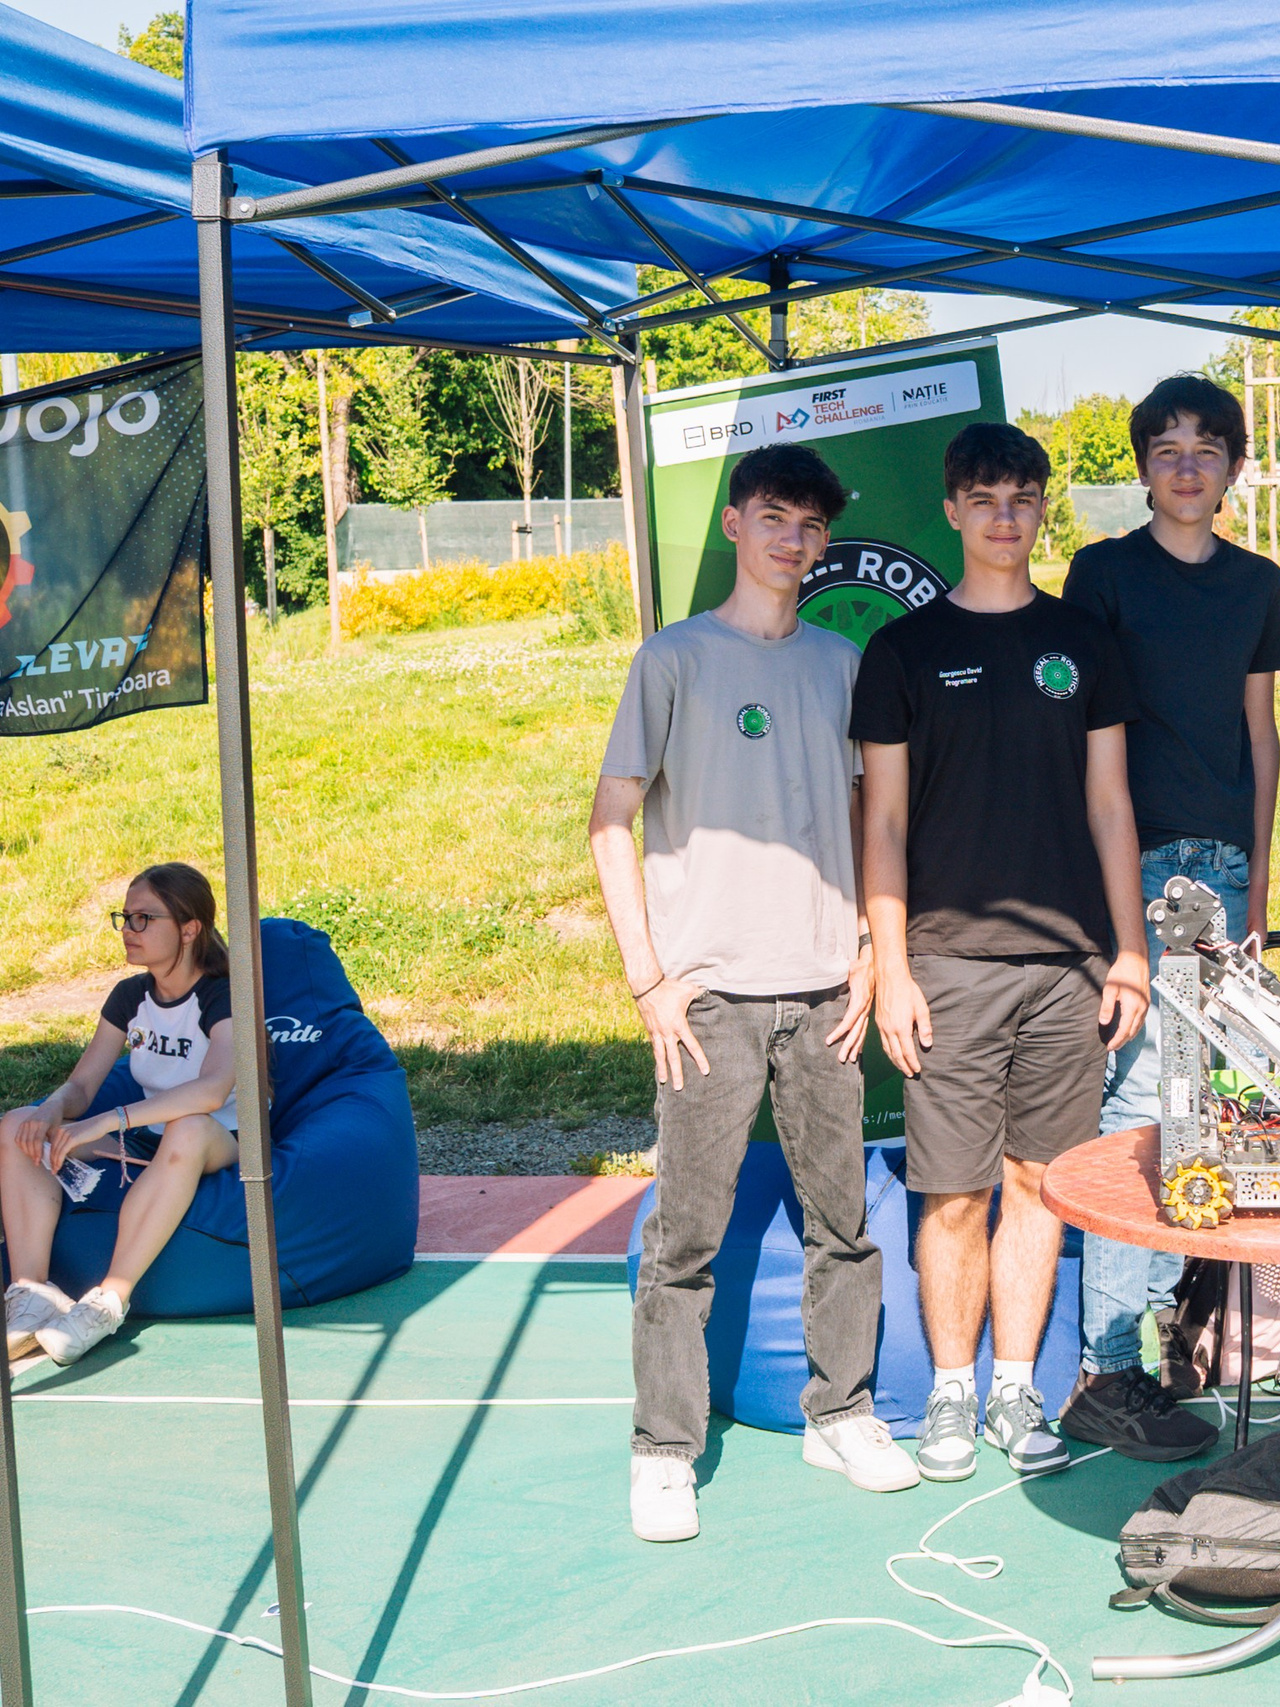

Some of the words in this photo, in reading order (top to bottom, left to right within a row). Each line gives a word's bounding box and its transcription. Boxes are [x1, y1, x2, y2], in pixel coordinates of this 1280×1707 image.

[812, 388, 846, 403] FIRST
[813, 400, 845, 414] TECH
[814, 404, 884, 424] CHALLENGE
[710, 421, 753, 440] BRD
[857, 551, 937, 608] ROB
[1060, 656, 1078, 693] ROBOTICS
